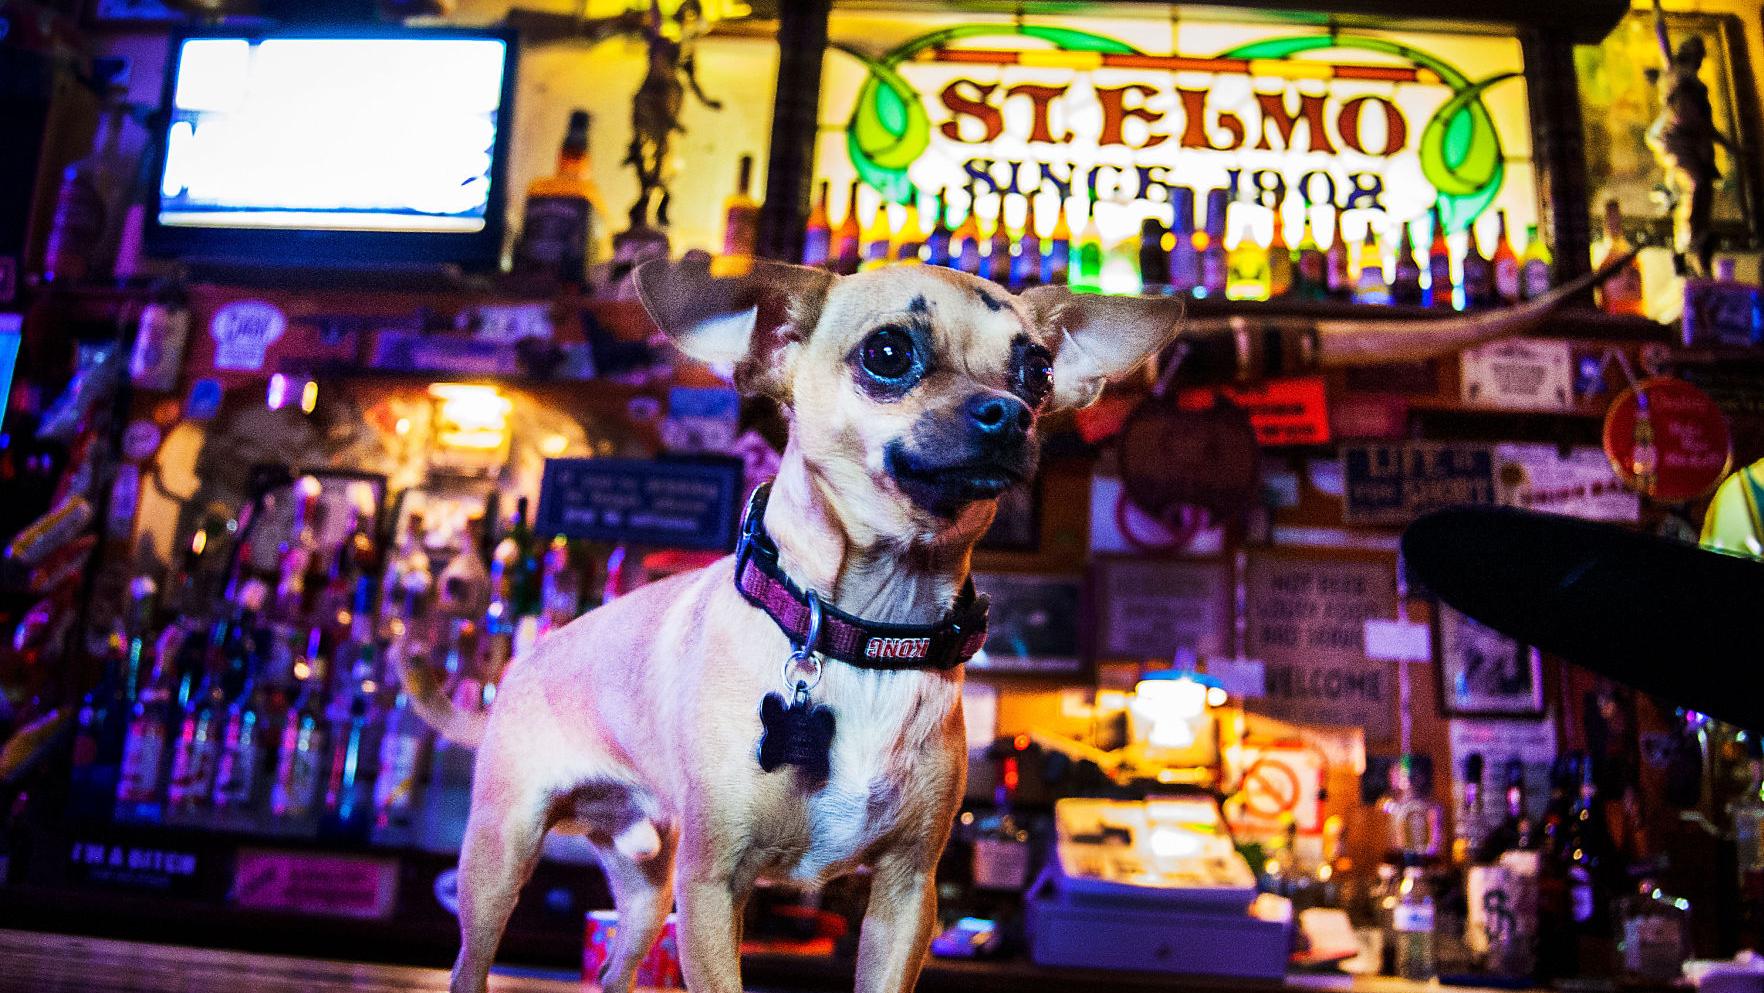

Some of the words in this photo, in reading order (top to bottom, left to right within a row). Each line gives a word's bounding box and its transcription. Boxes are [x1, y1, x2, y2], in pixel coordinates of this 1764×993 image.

[1095, 84, 1408, 156] ELMO
[961, 159, 1171, 205] SINCE
[1227, 168, 1388, 211] 1908
[864, 637, 930, 658] KONG
